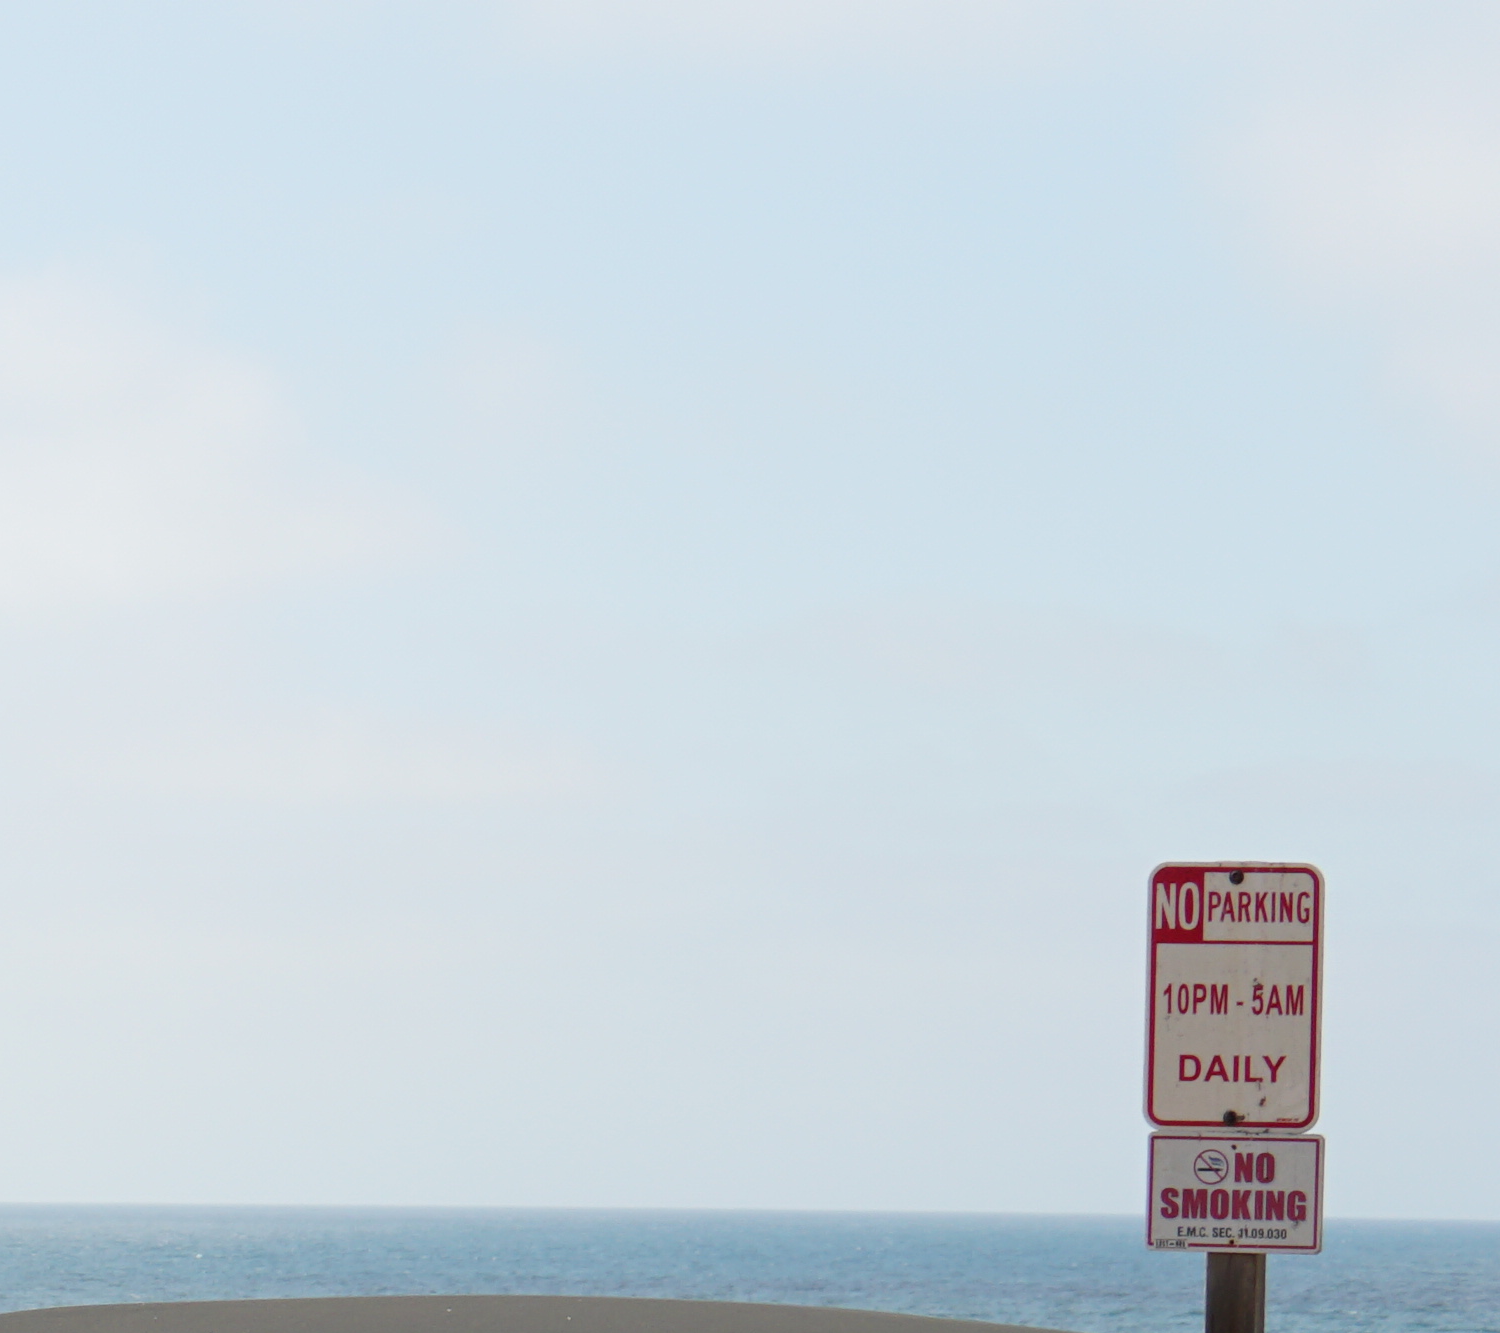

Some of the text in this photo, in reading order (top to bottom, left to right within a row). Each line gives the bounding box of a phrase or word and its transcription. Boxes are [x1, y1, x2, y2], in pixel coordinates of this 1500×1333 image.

[1155, 882, 1311, 930] NO PARKING
[1163, 983, 1229, 1015] 10PM
[1251, 984, 1305, 1016] 5AM
[1179, 1054, 1287, 1083] DAILY
[1234, 1152, 1276, 1184] NO
[1160, 1187, 1307, 1222] SMOKING
[1177, 1226, 1209, 1238] E.M.C.
[1212, 1227, 1235, 1238] SEC.
